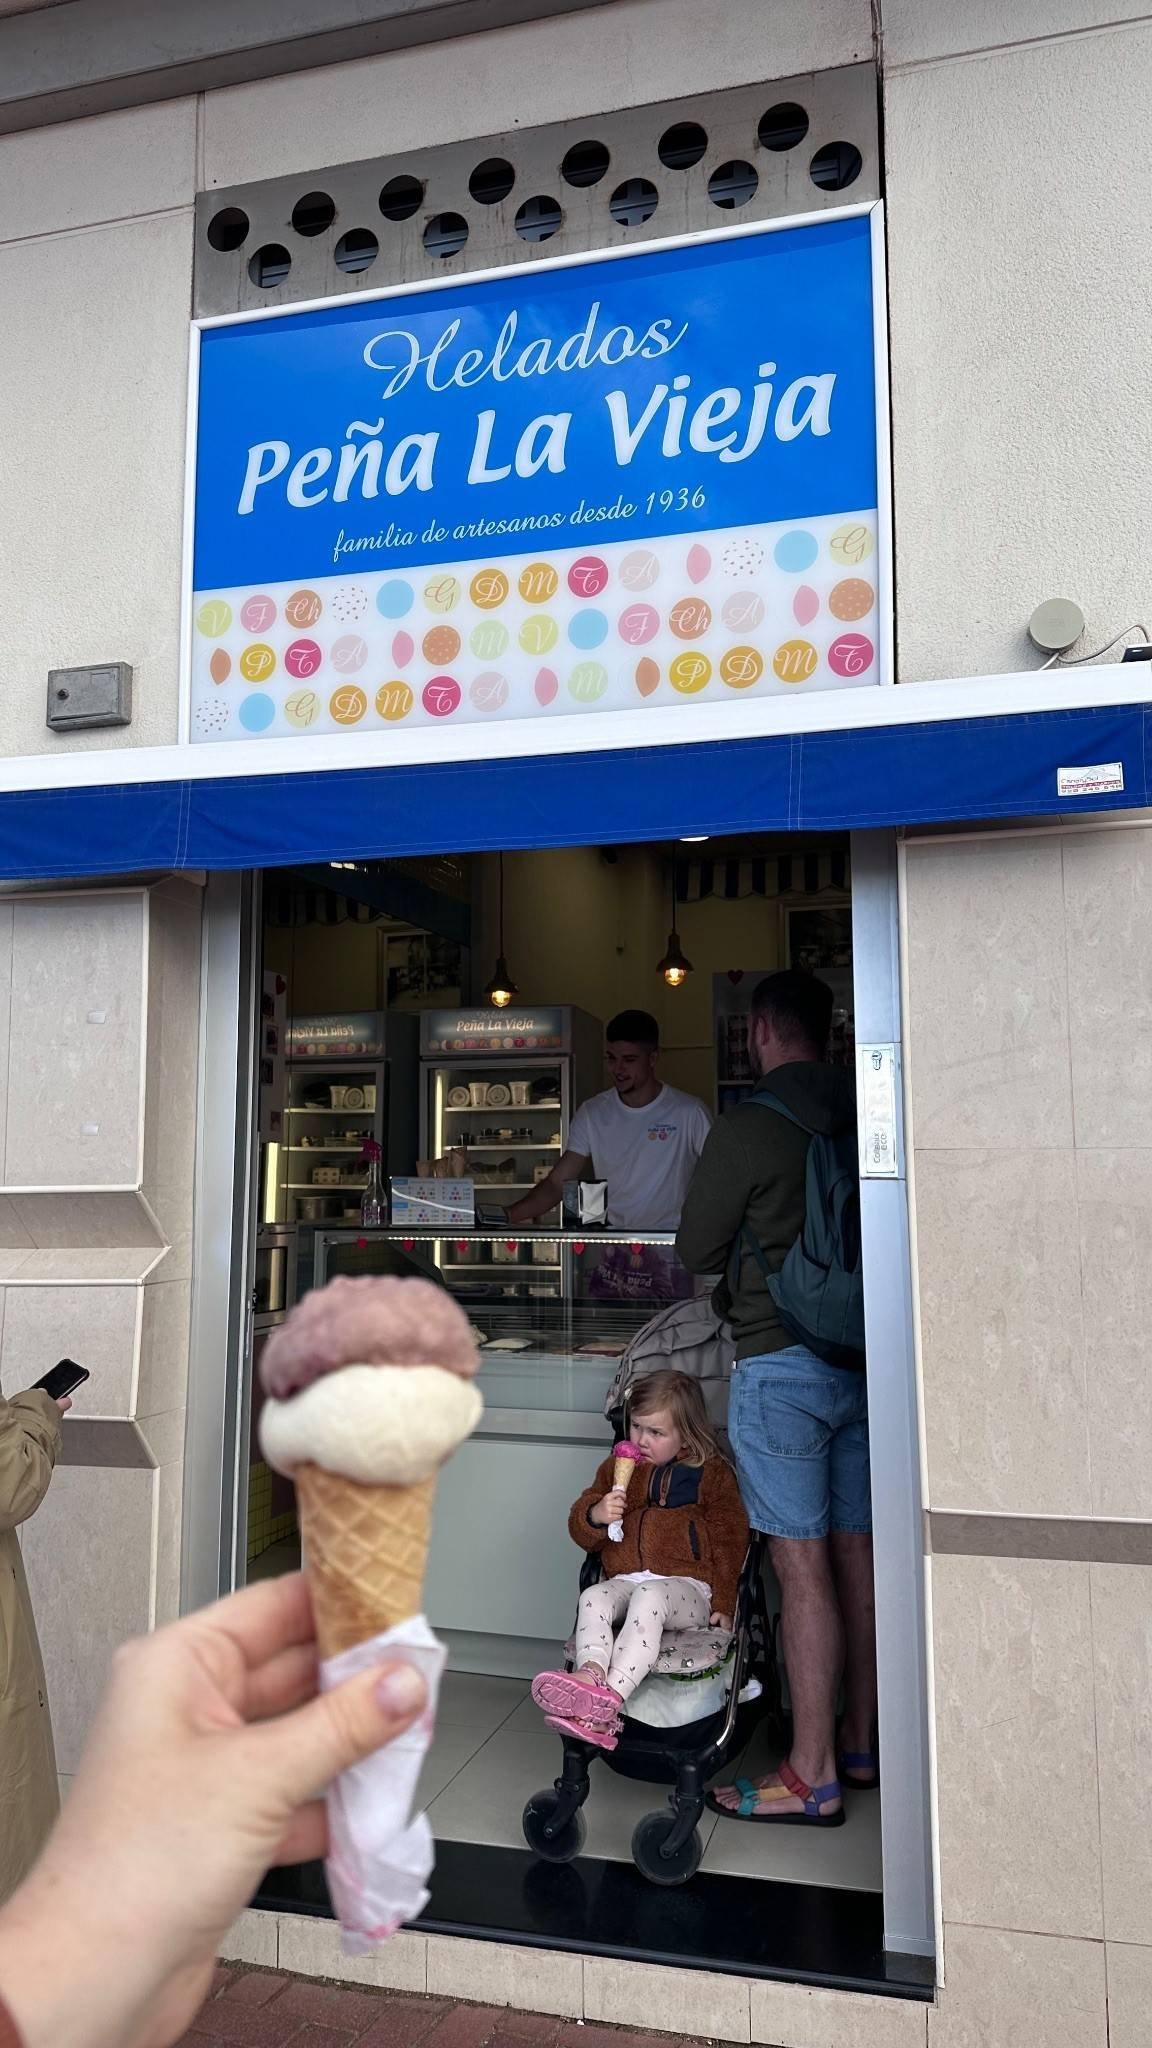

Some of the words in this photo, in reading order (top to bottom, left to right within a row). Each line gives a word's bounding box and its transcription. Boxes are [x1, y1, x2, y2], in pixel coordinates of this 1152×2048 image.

[363, 302, 689, 399] Helados
[238, 417, 440, 515] Peña
[468, 409, 572, 485] La
[605, 361, 837, 466] Vieja
[333, 524, 416, 562] familia
[422, 520, 448, 542] de
[453, 509, 566, 539] artesanos
[570, 494, 637, 522] desde
[646, 484, 706, 515] 1936
[476, 575, 504, 604] D
[520, 570, 557, 597] M
[670, 606, 709, 633] Ch
[335, 691, 363, 719] D
[377, 688, 412, 715] M
[727, 651, 759, 682] D
[775, 648, 816, 676] M
[456, 1019, 484, 1031] Peña
[488, 1019, 502, 1031] La
[506, 1017, 535, 1031] Vieja
